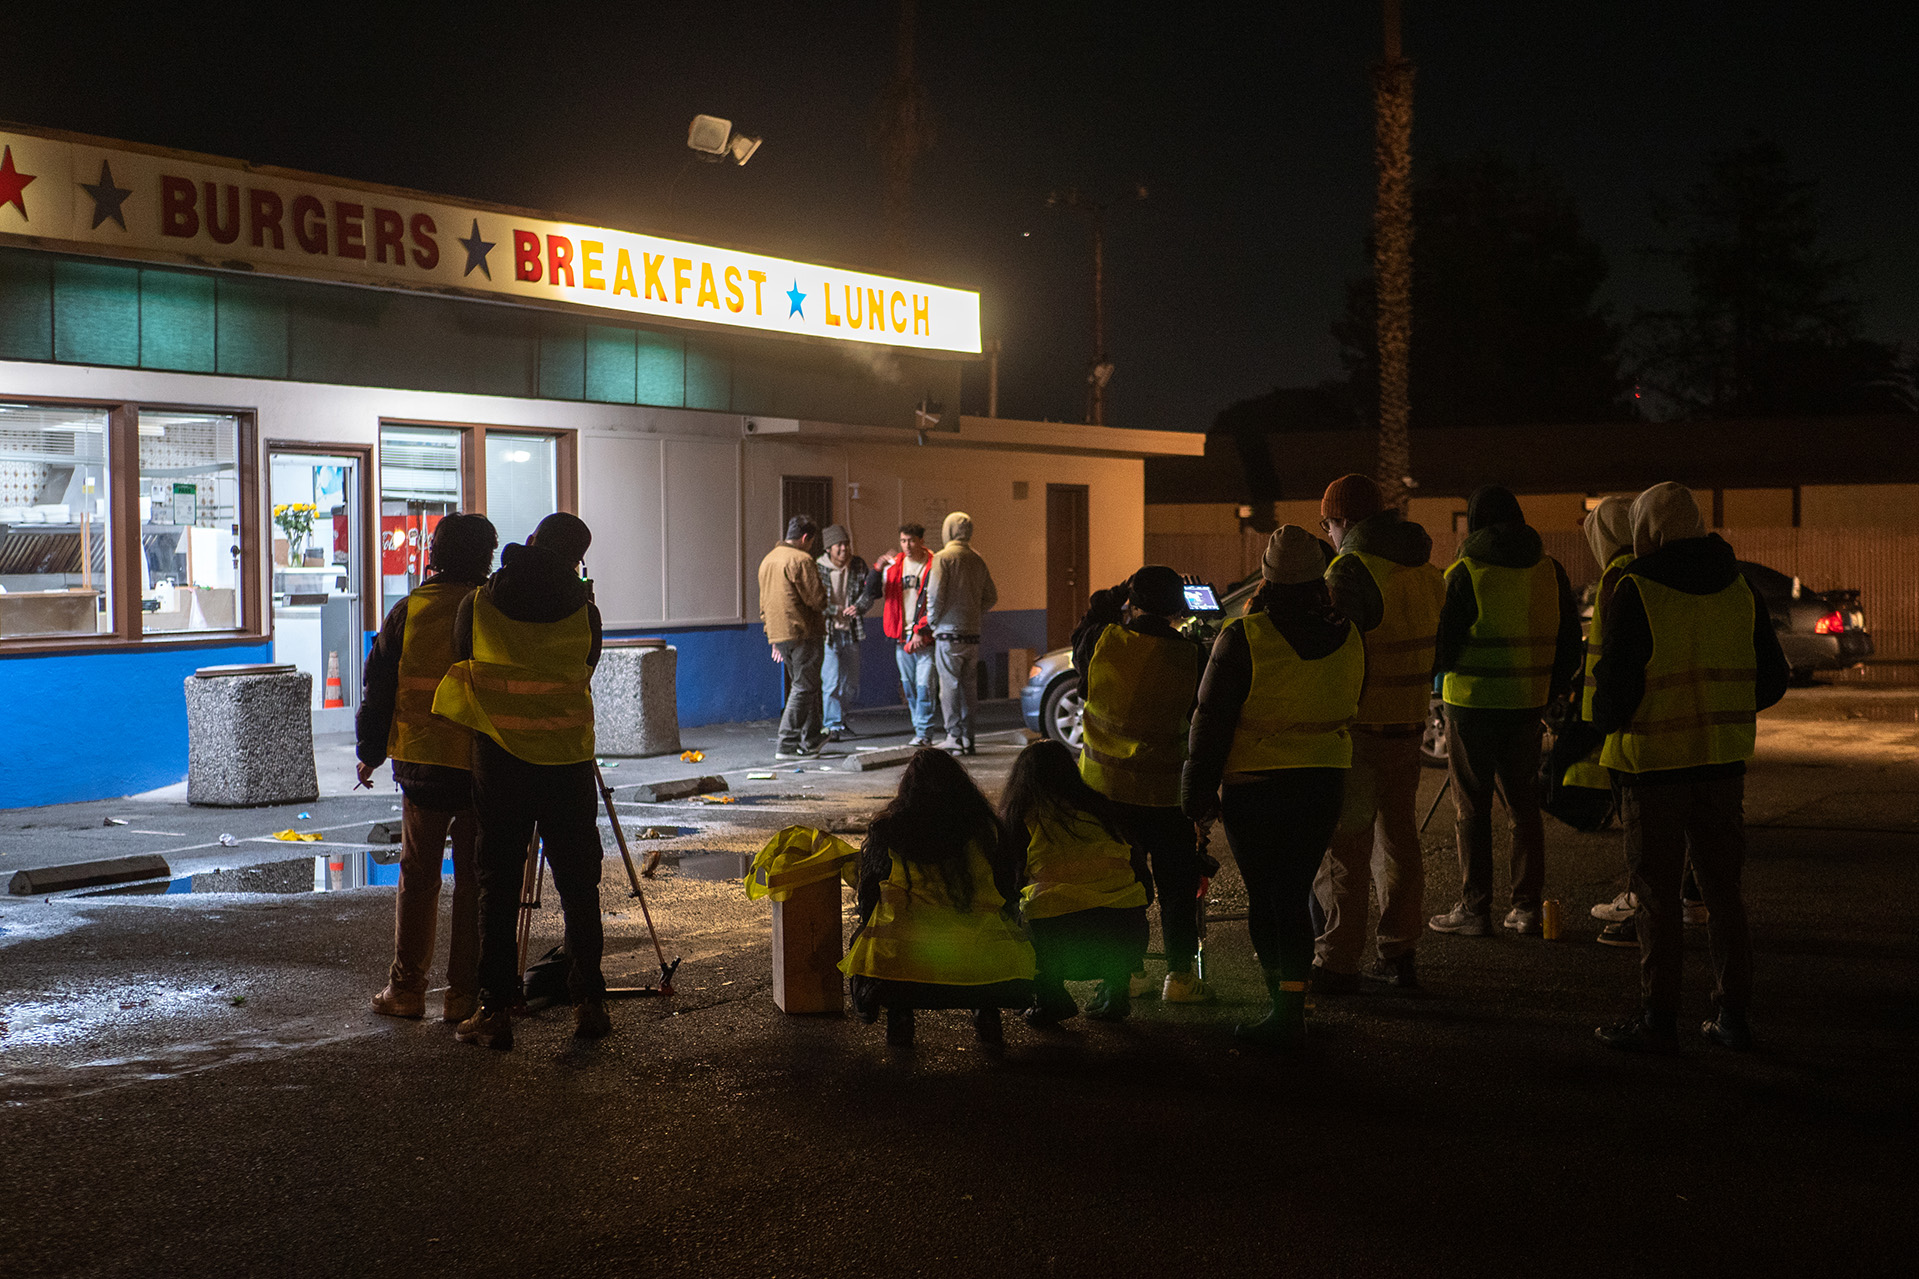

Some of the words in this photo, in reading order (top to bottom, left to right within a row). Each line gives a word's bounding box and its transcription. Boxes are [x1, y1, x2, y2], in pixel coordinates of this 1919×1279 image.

[161, 175, 440, 270] BURGERS
[512, 229, 767, 315] BREAKFAST
[823, 282, 931, 336] LUNCH
